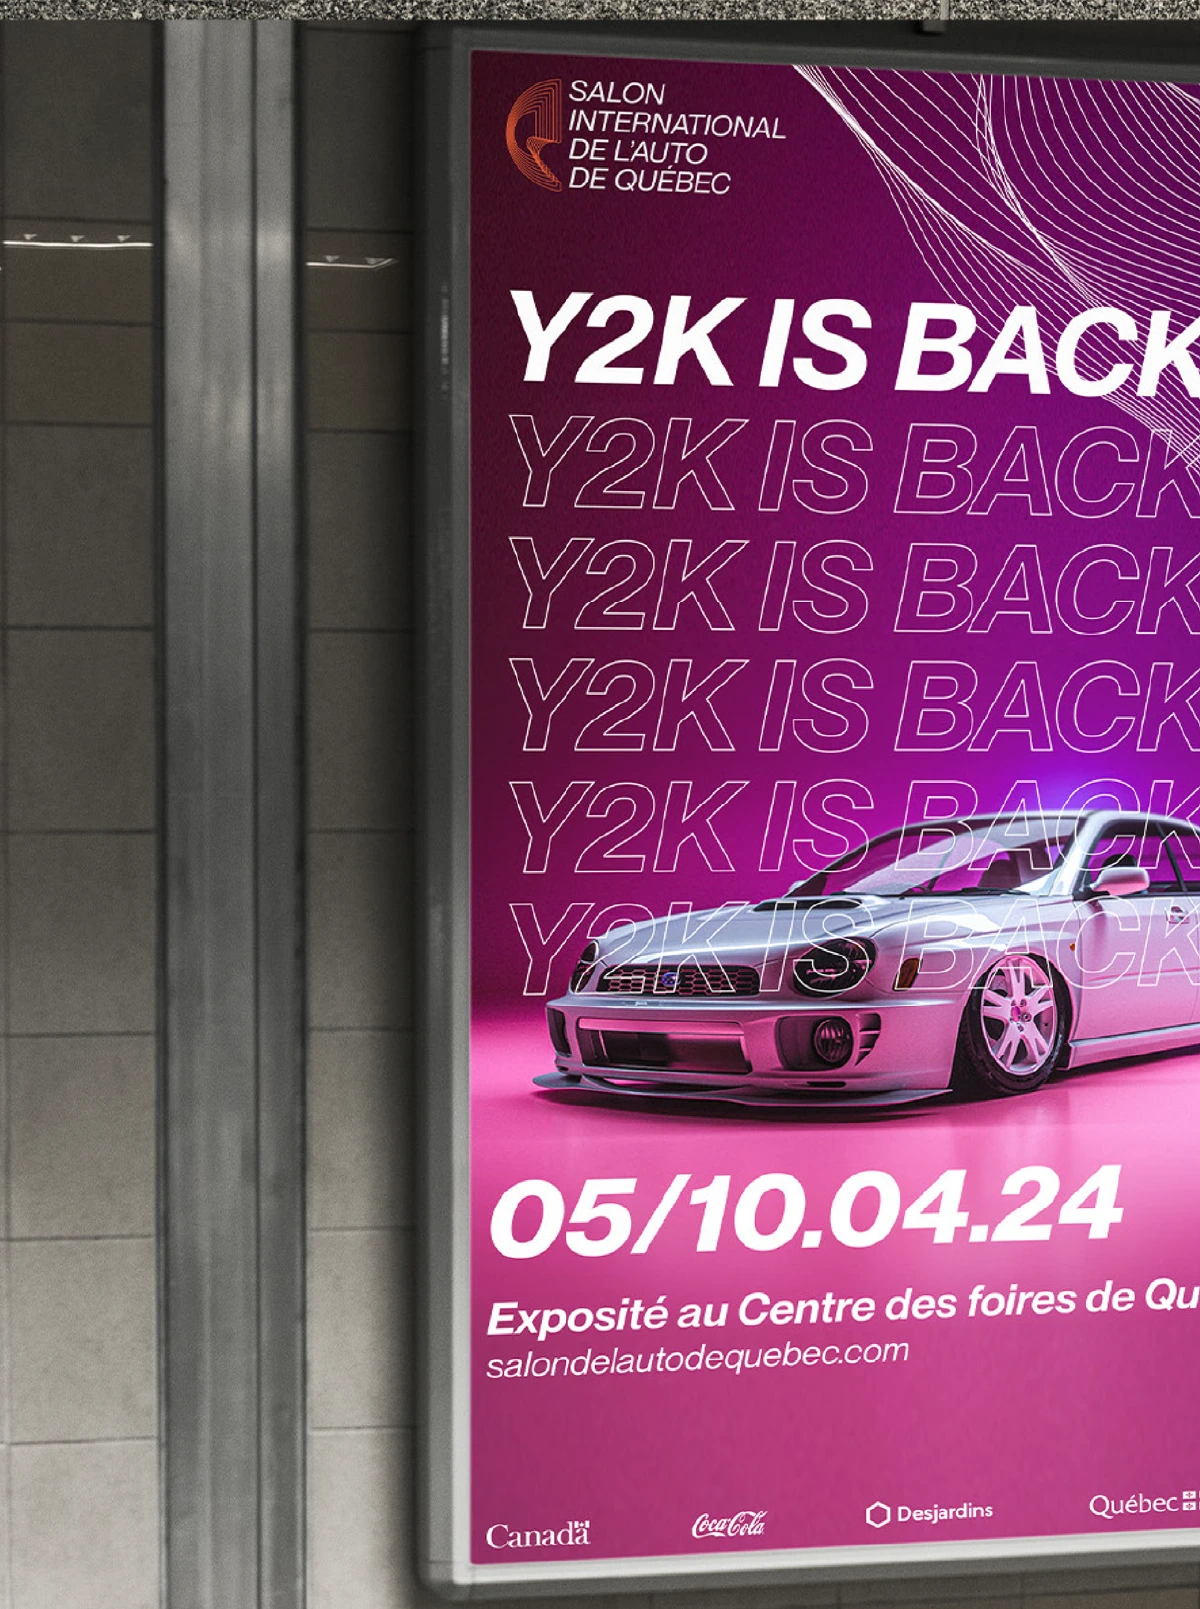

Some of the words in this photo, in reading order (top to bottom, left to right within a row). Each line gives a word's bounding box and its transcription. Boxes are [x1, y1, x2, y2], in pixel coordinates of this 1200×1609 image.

[568, 79, 666, 105] SALON
[568, 108, 787, 139] INTERNATIONAL
[568, 138, 609, 161] DE
[613, 140, 708, 165] L'AUTO
[568, 166, 607, 190] DE
[614, 164, 732, 195] QUÉBEC
[509, 290, 750, 386] Y2K
[758, 299, 874, 390] IS
[509, 414, 750, 511] Y2K
[758, 419, 874, 514] IS
[509, 536, 750, 631] Y2K
[758, 539, 874, 634] IS
[509, 657, 750, 751] Y2K
[758, 658, 874, 753] IS
[509, 781, 750, 874] Y2K
[758, 778, 874, 873] IS
[509, 901, 750, 996] Y2K
[758, 898, 874, 993] IS
[489, 1164, 1125, 1259] 05/10.04.24
[486, 1294, 671, 1341] Exposité
[676, 1302, 729, 1329] au
[737, 1291, 877, 1326] Centre
[884, 1287, 957, 1321] des
[967, 1283, 1077, 1318] foires
[1085, 1279, 1135, 1313] de
[486, 1340, 910, 1379] salondelautodequebec.com
[897, 1502, 993, 1525] Desjardins
[1089, 1493, 1180, 1519] Québec
[485, 1520, 591, 1549] Canada
